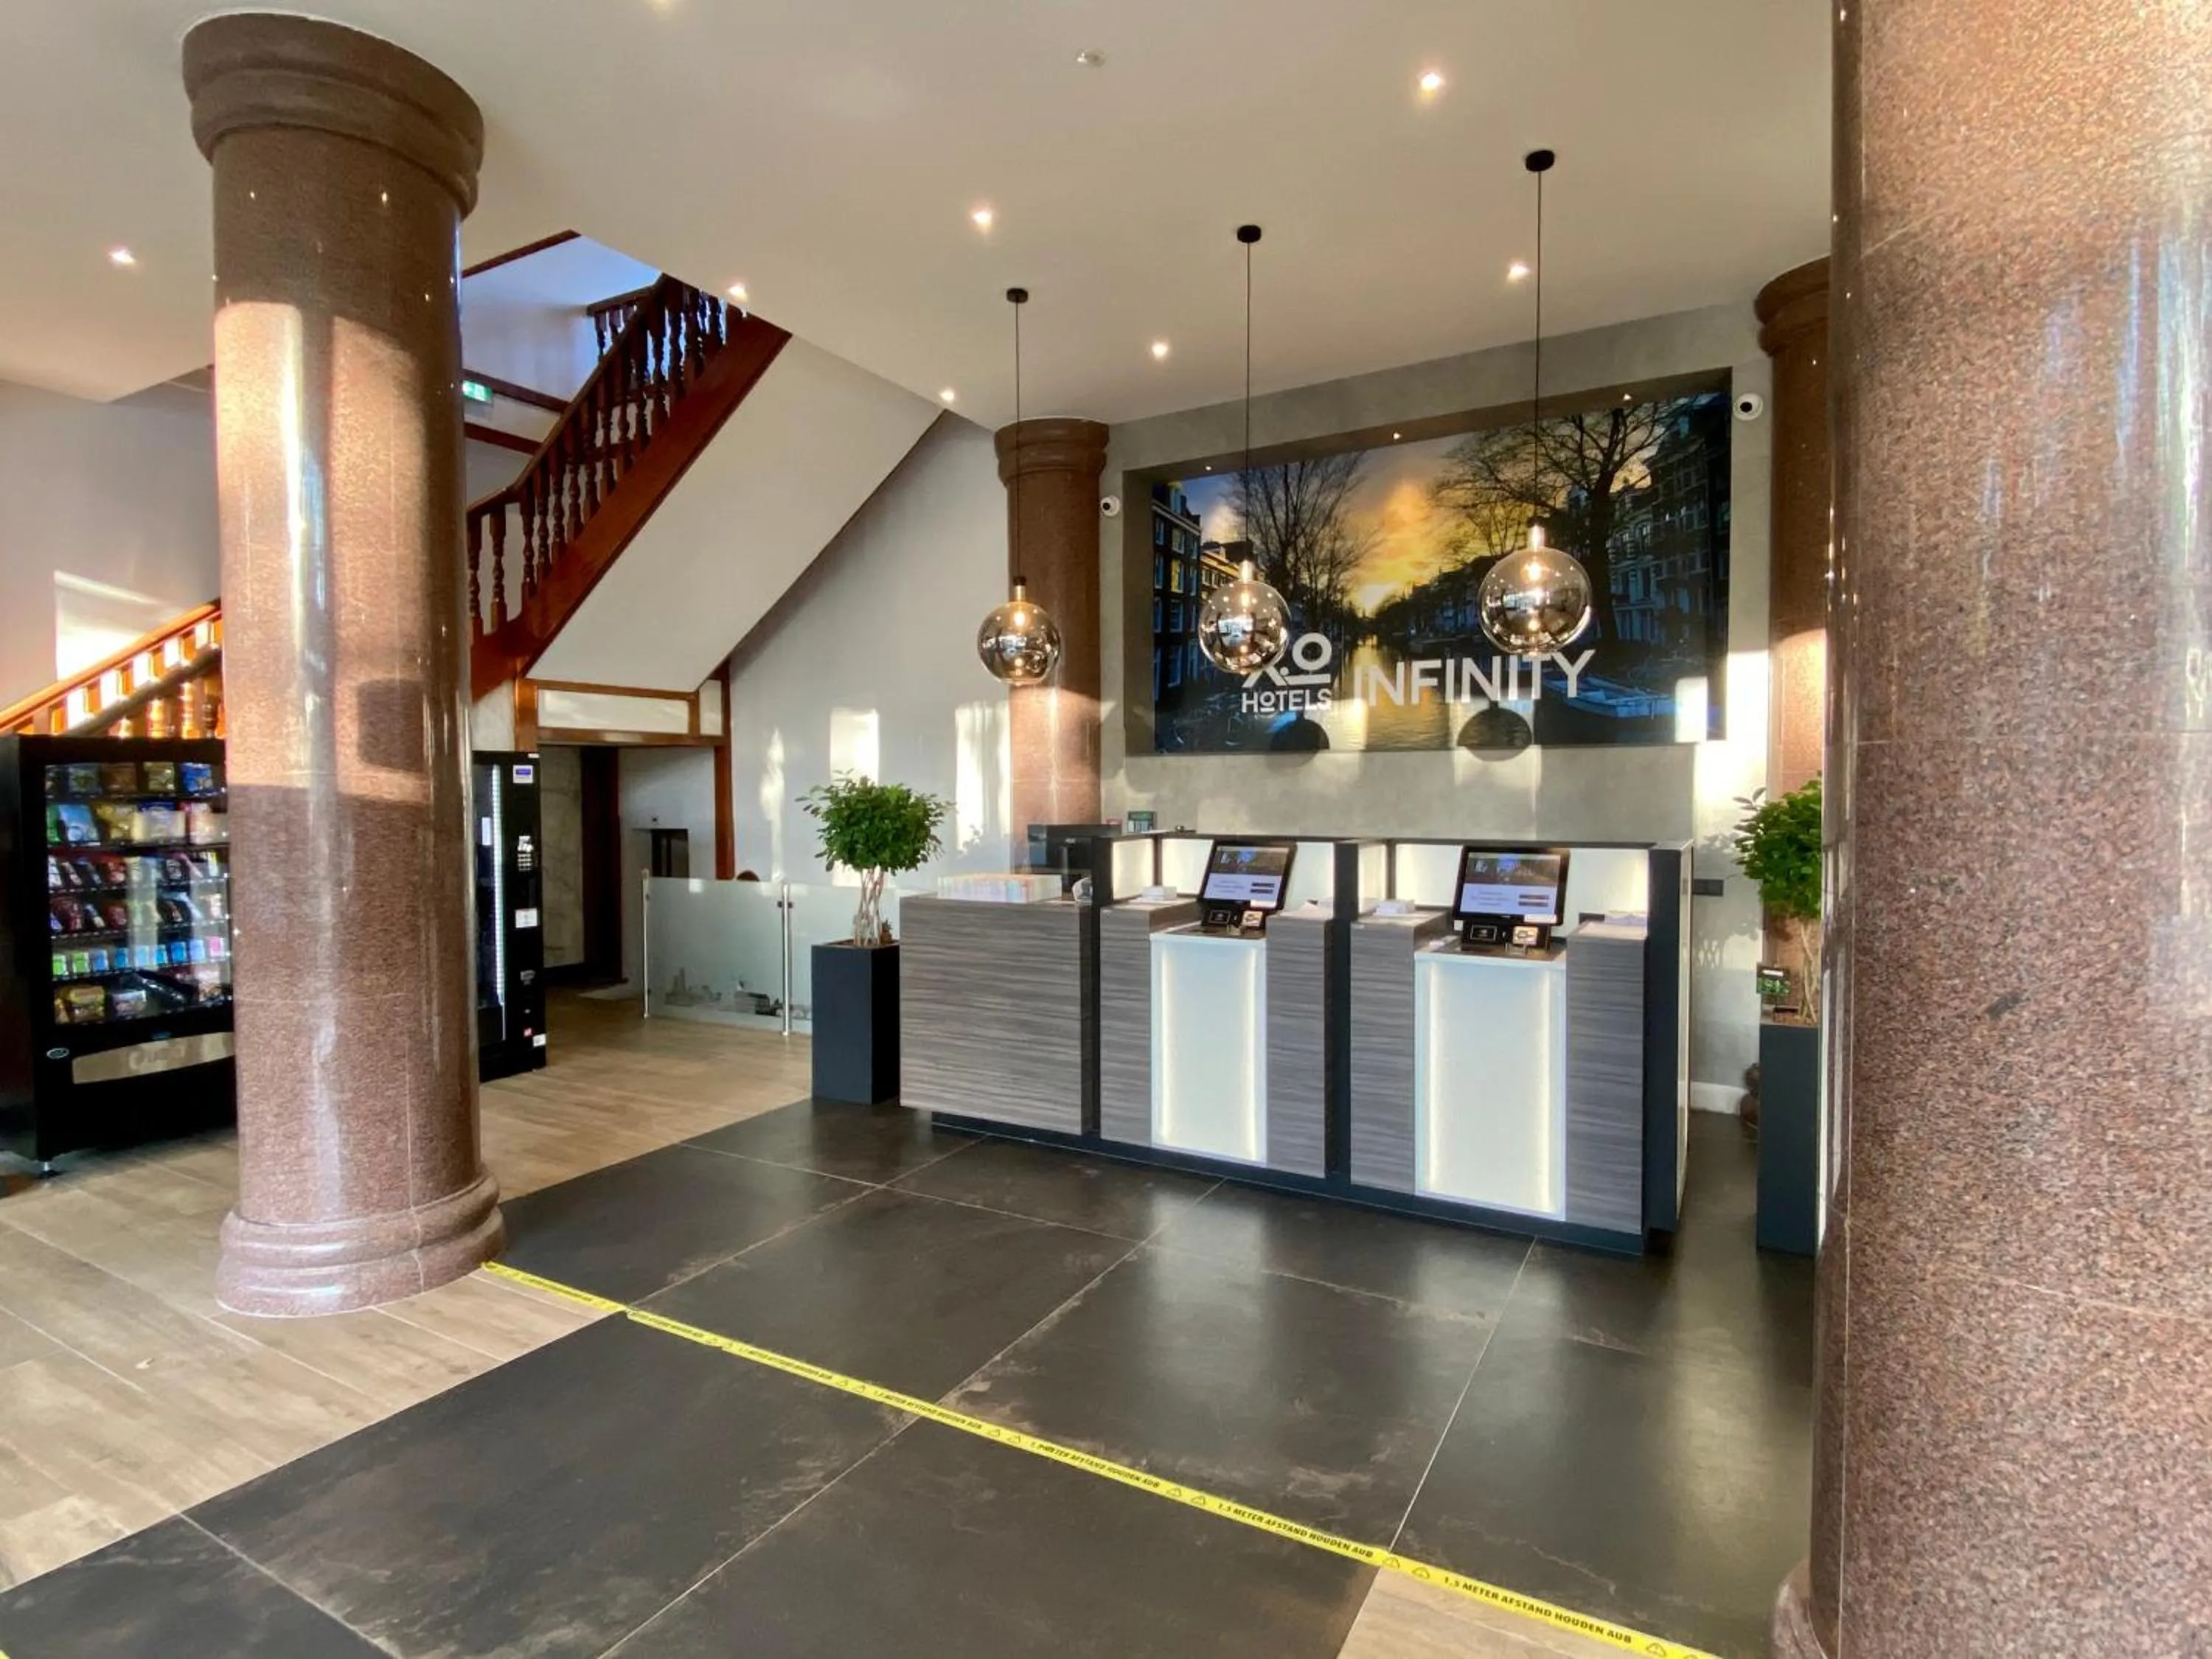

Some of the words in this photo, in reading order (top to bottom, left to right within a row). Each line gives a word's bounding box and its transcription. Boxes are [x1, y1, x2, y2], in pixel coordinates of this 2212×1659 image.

[1354, 649, 1596, 706] INFINITY
[1241, 688, 1332, 713] HOTELS
[1265, 1517, 1307, 1537] AFSTAND
[1462, 1582, 1500, 1600] METER
[1500, 1595, 1552, 1618] AFSTAND
[1554, 1612, 1604, 1635] HOUDEN
[1607, 1630, 1632, 1644] AUB
